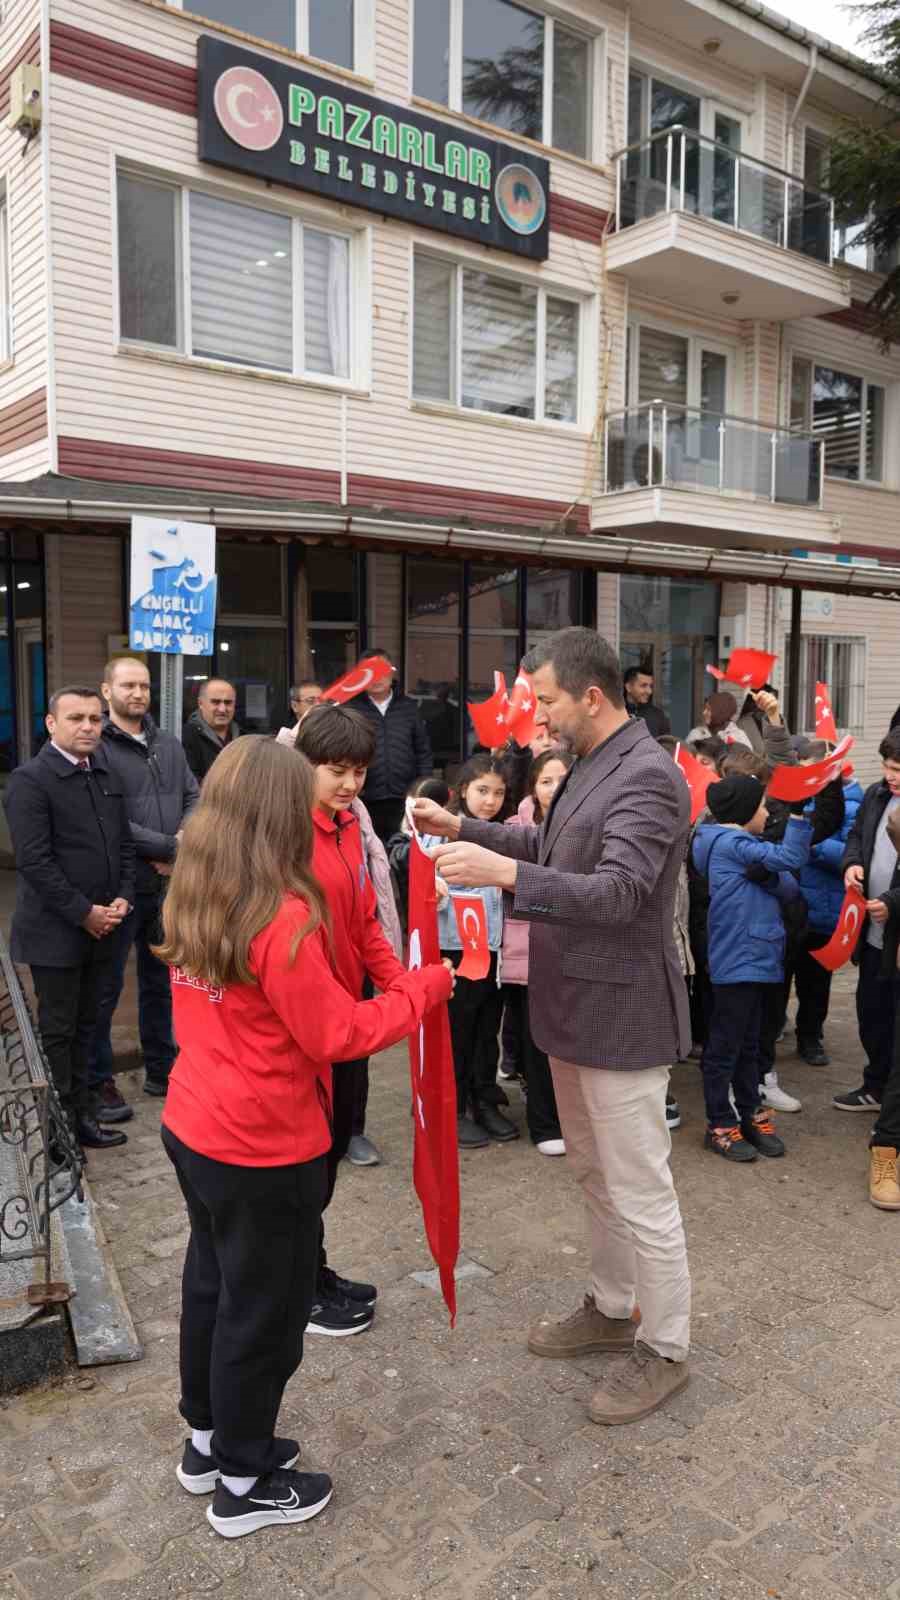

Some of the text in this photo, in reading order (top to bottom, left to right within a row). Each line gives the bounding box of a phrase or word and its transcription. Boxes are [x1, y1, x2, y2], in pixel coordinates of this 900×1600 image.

[288, 83, 491, 191] PAZARLAR
[289, 139, 491, 224] BELEDİYESİ
[134, 630, 172, 649] PARK
[152, 613, 192, 632] ARAÇ
